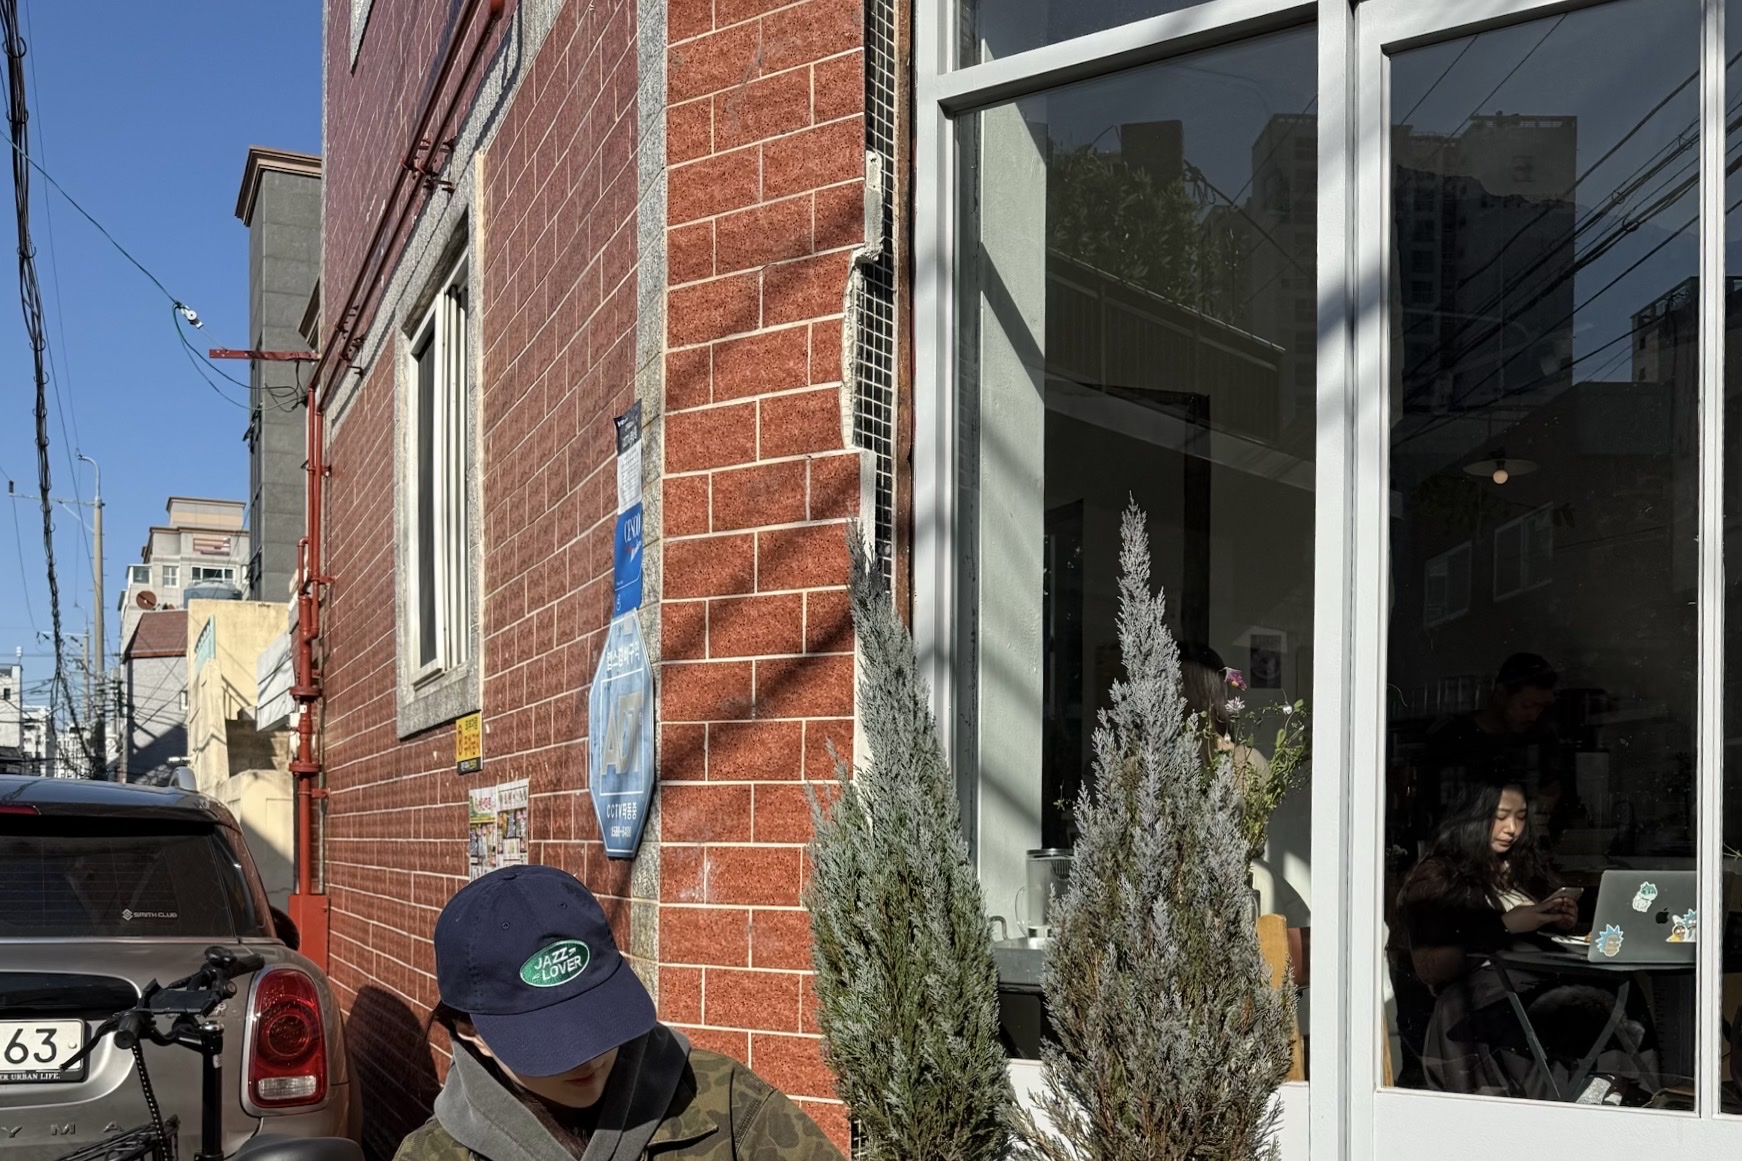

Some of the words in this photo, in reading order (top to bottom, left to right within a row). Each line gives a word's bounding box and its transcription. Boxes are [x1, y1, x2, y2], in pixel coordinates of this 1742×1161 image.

[533, 946, 569, 970] JAZZ
[541, 955, 583, 981] LOVER
[3, 1027, 58, 1065] 63
[10, 1073, 38, 1081] URBAN
[40, 1072, 61, 1080] LIFE.
